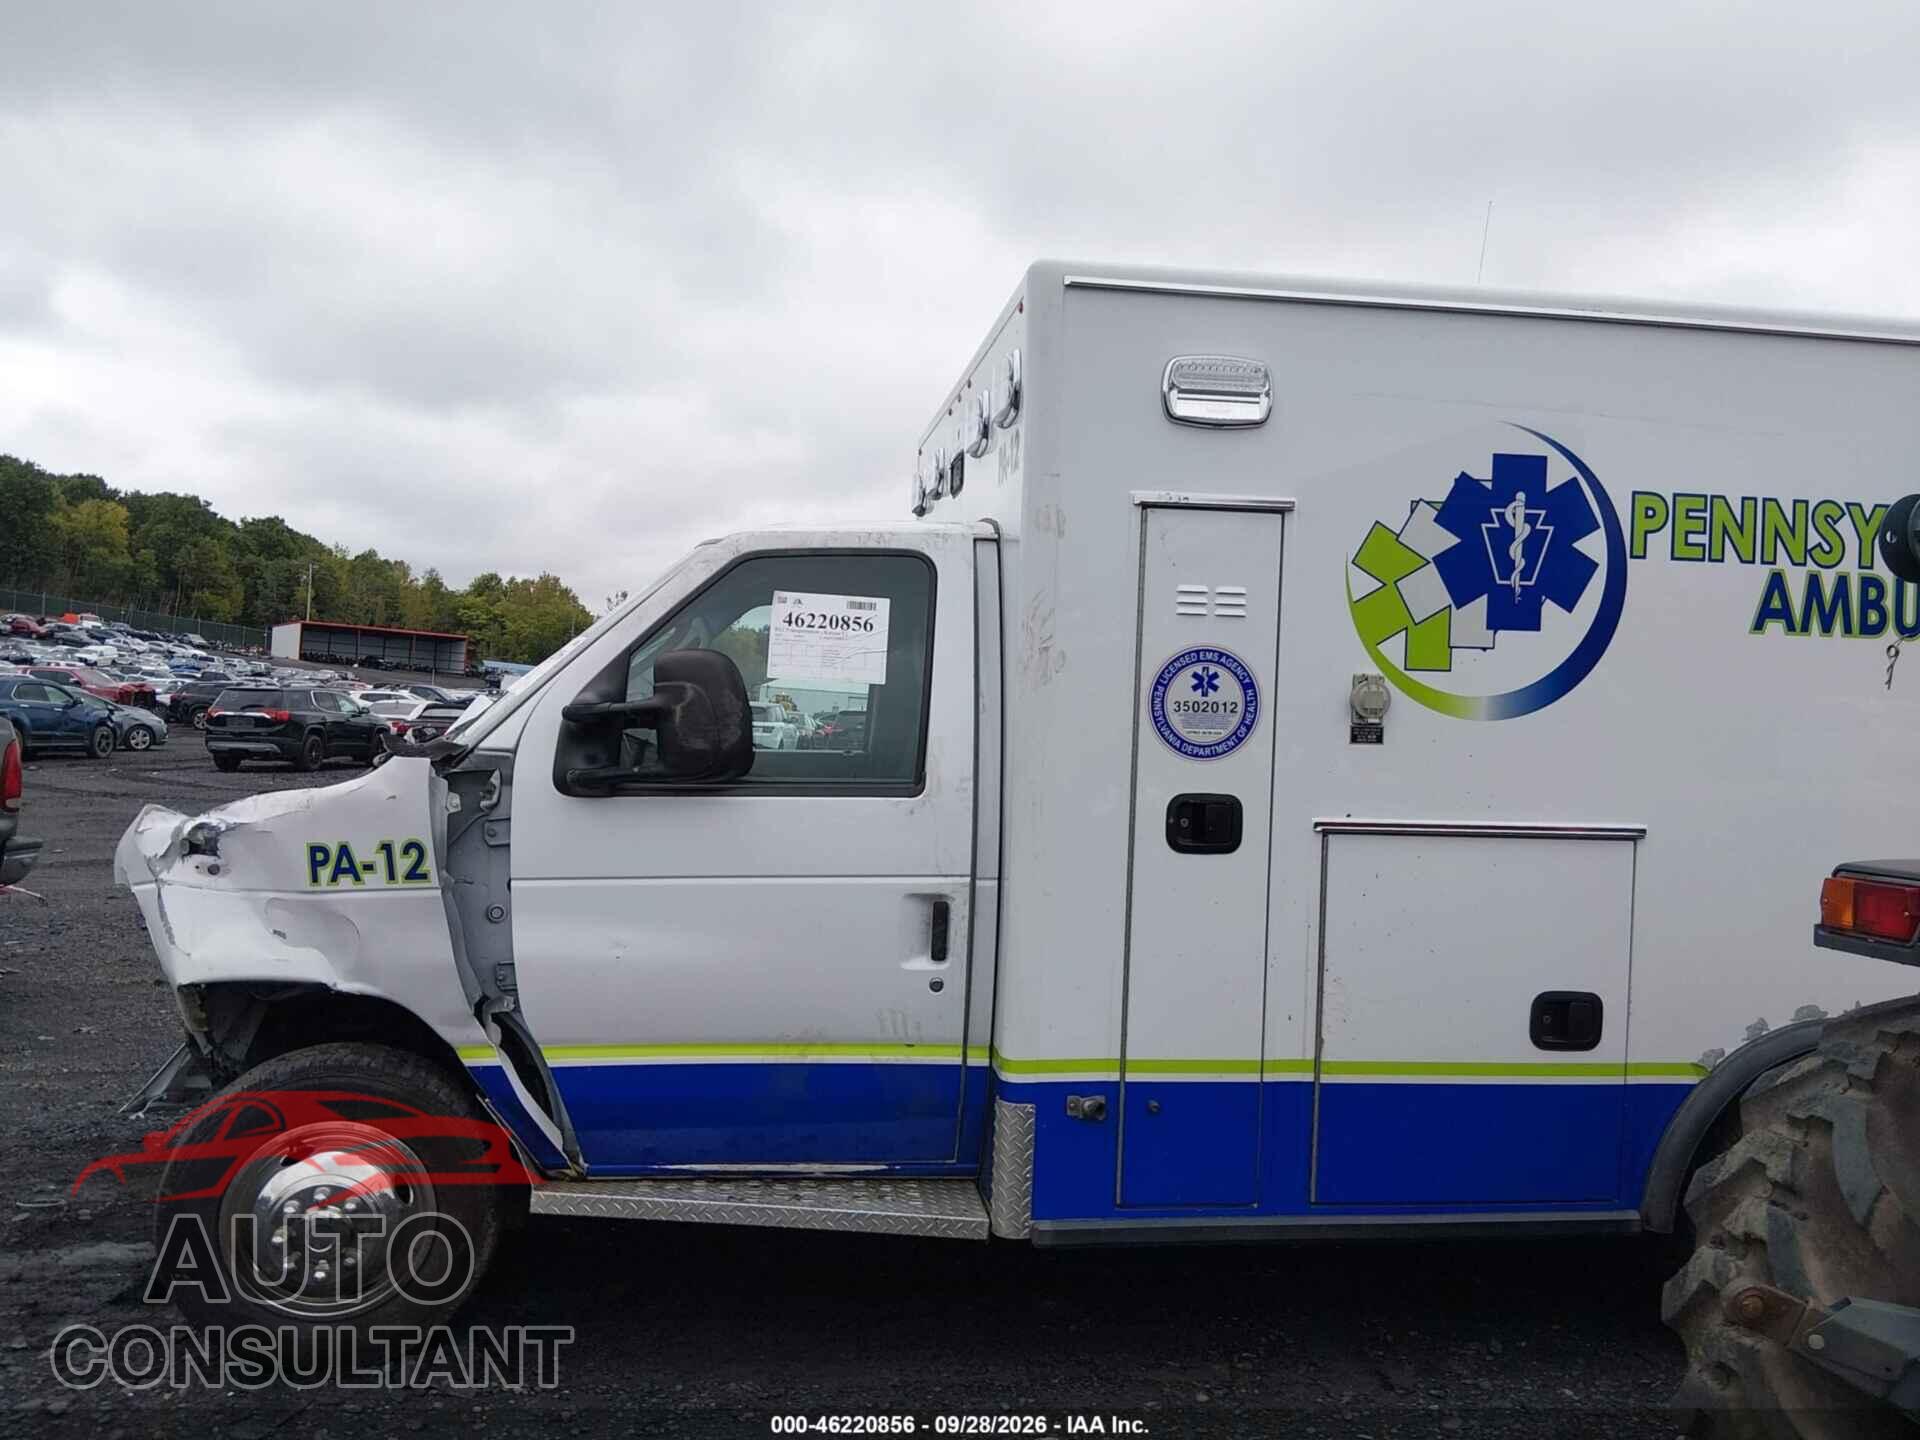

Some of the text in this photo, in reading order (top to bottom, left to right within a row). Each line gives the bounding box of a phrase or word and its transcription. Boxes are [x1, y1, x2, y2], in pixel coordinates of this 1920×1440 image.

[783, 611, 874, 632] 46220856
[1161, 651, 1252, 685] LICENSED EMS AGENCY
[1152, 685, 1182, 748] PENNSYLVANIA
[1181, 735, 1240, 757] DEPARTMENT
[1236, 725, 1249, 738] OF
[1245, 689, 1257, 725] HEALTH
[1173, 700, 1238, 714] 3502012
[306, 838, 432, 887] PA-12
